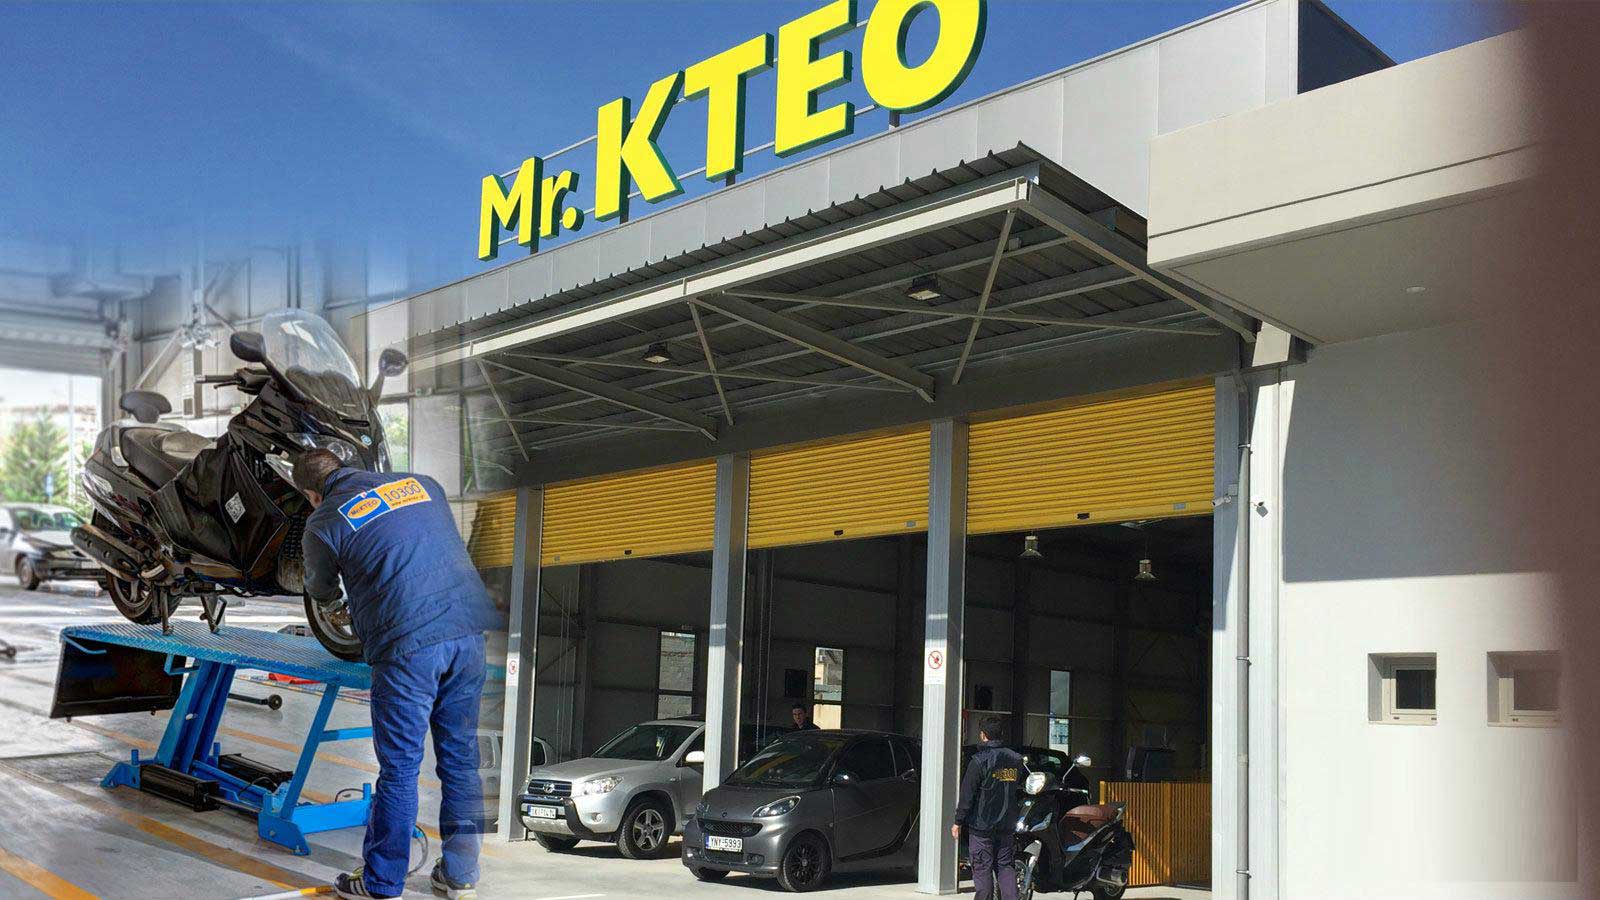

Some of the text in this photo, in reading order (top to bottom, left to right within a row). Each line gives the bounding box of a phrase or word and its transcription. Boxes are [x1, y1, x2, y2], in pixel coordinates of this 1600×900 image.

[478, 0, 988, 262] Mr. KTEO
[384, 483, 421, 501] 10300
[710, 836, 742, 849] YNY-5993
